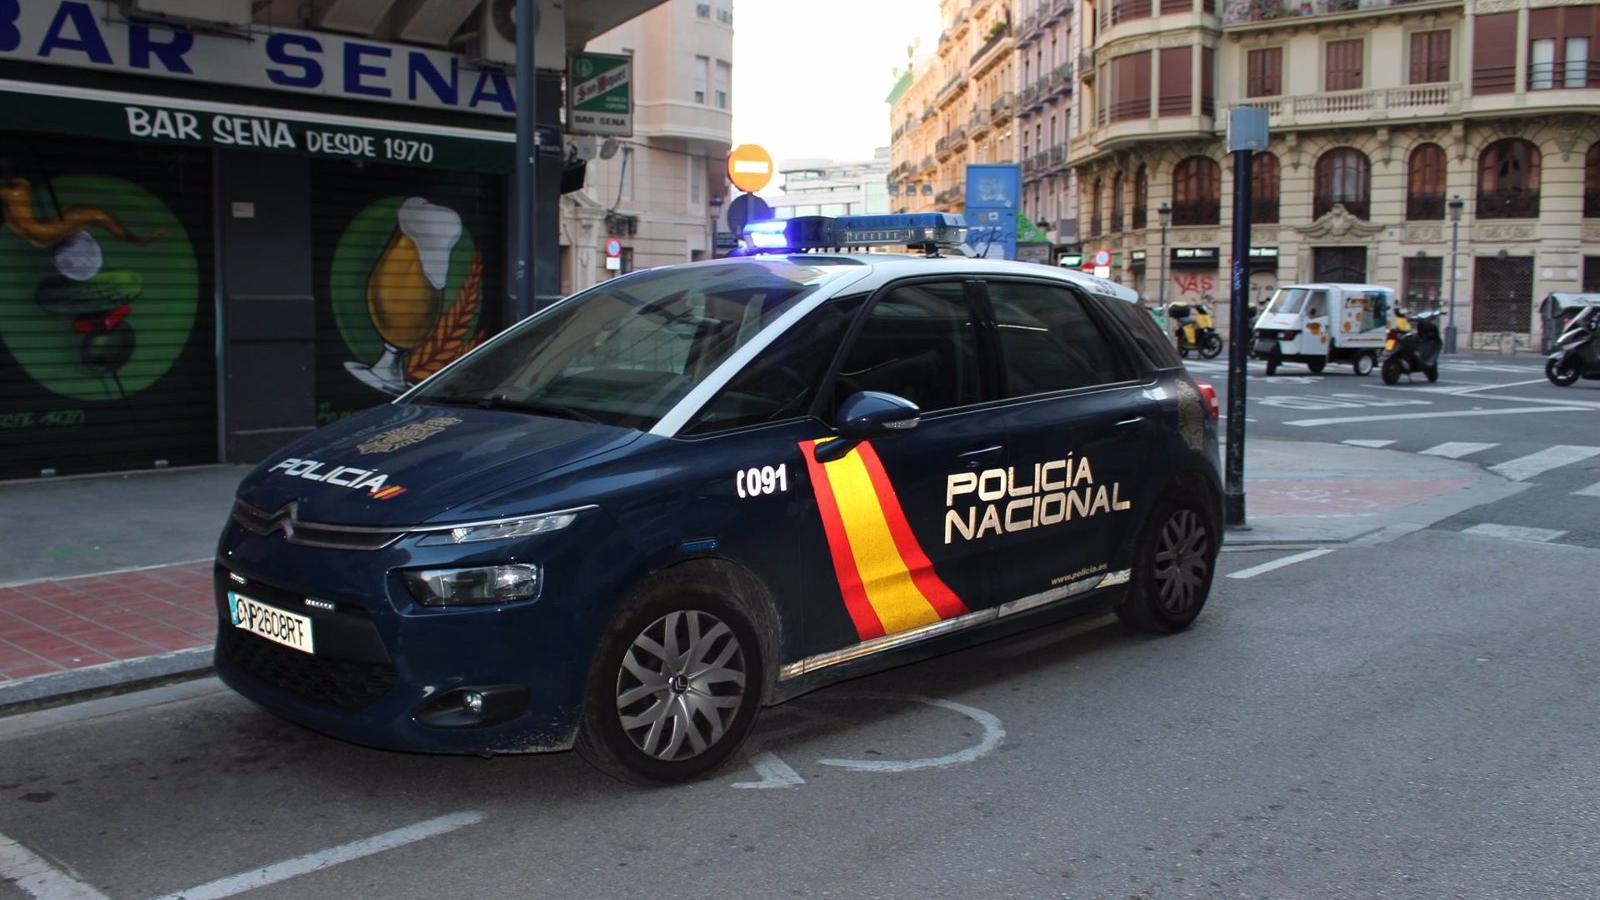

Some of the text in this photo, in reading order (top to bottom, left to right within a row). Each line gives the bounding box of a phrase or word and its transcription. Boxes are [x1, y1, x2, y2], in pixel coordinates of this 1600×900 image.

[265, 32, 517, 112] SENA
[124, 106, 434, 163] BAR SENA DESDE 1970
[574, 115, 626, 126] BAR SENA
[268, 458, 390, 494] POLICÍA
[946, 451, 1093, 507] POLICÍA
[944, 482, 1131, 544] NACIONAL
